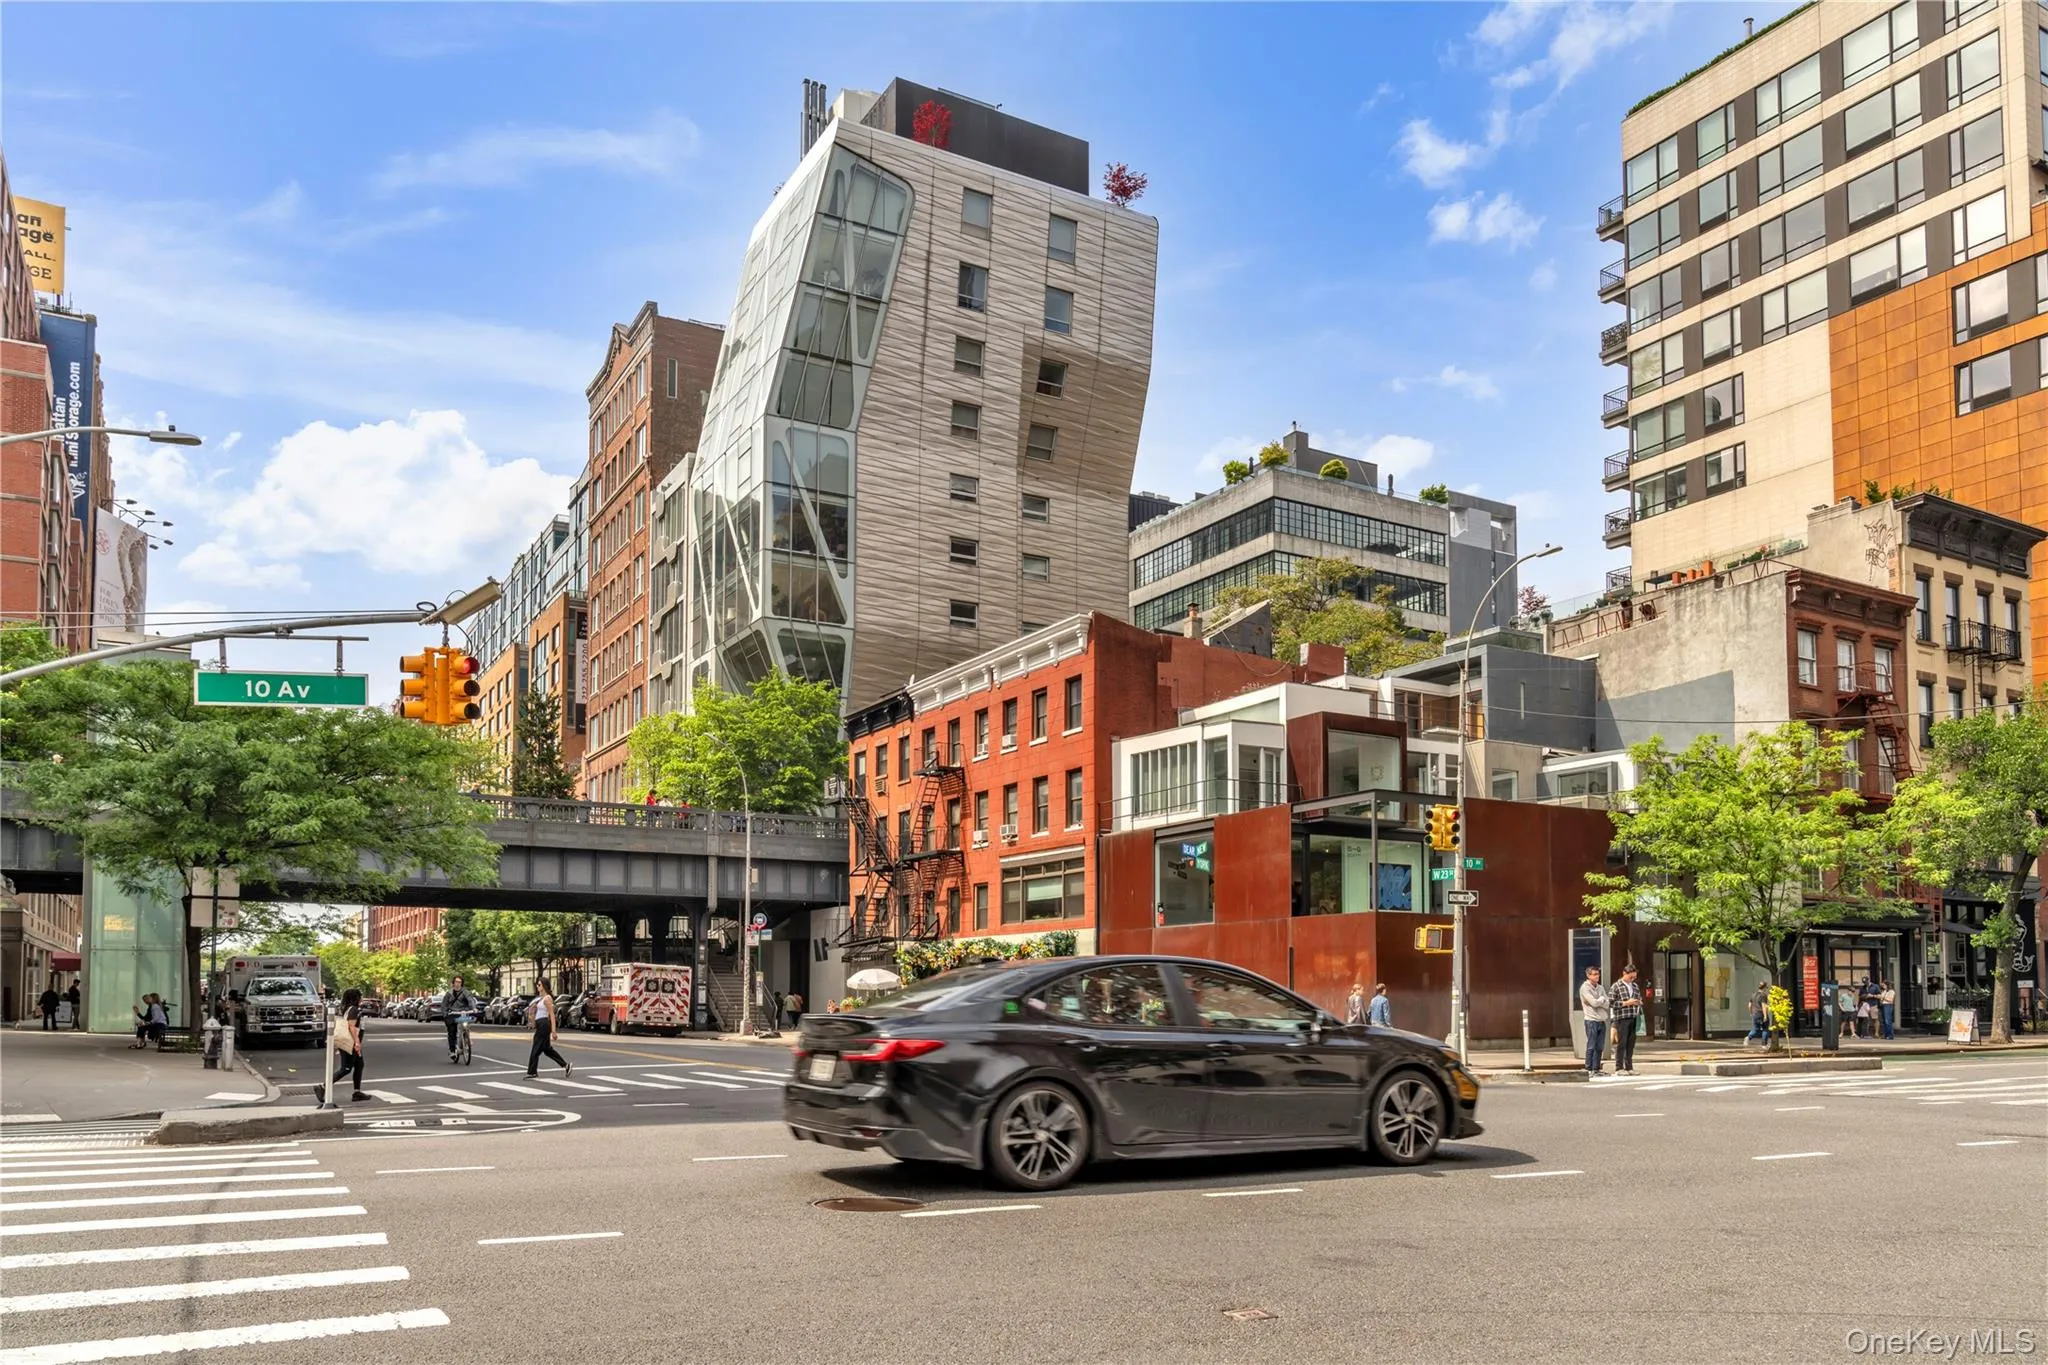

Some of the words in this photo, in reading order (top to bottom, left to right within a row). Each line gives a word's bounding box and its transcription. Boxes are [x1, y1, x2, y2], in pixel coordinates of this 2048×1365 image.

[65, 361, 82, 441] Sorage.com
[245, 680, 271, 698] 10
[277, 681, 310, 698] Av
[1466, 859, 1473, 868] 10
[1433, 870, 1441, 880] W
[1441, 870, 1449, 880] 23
